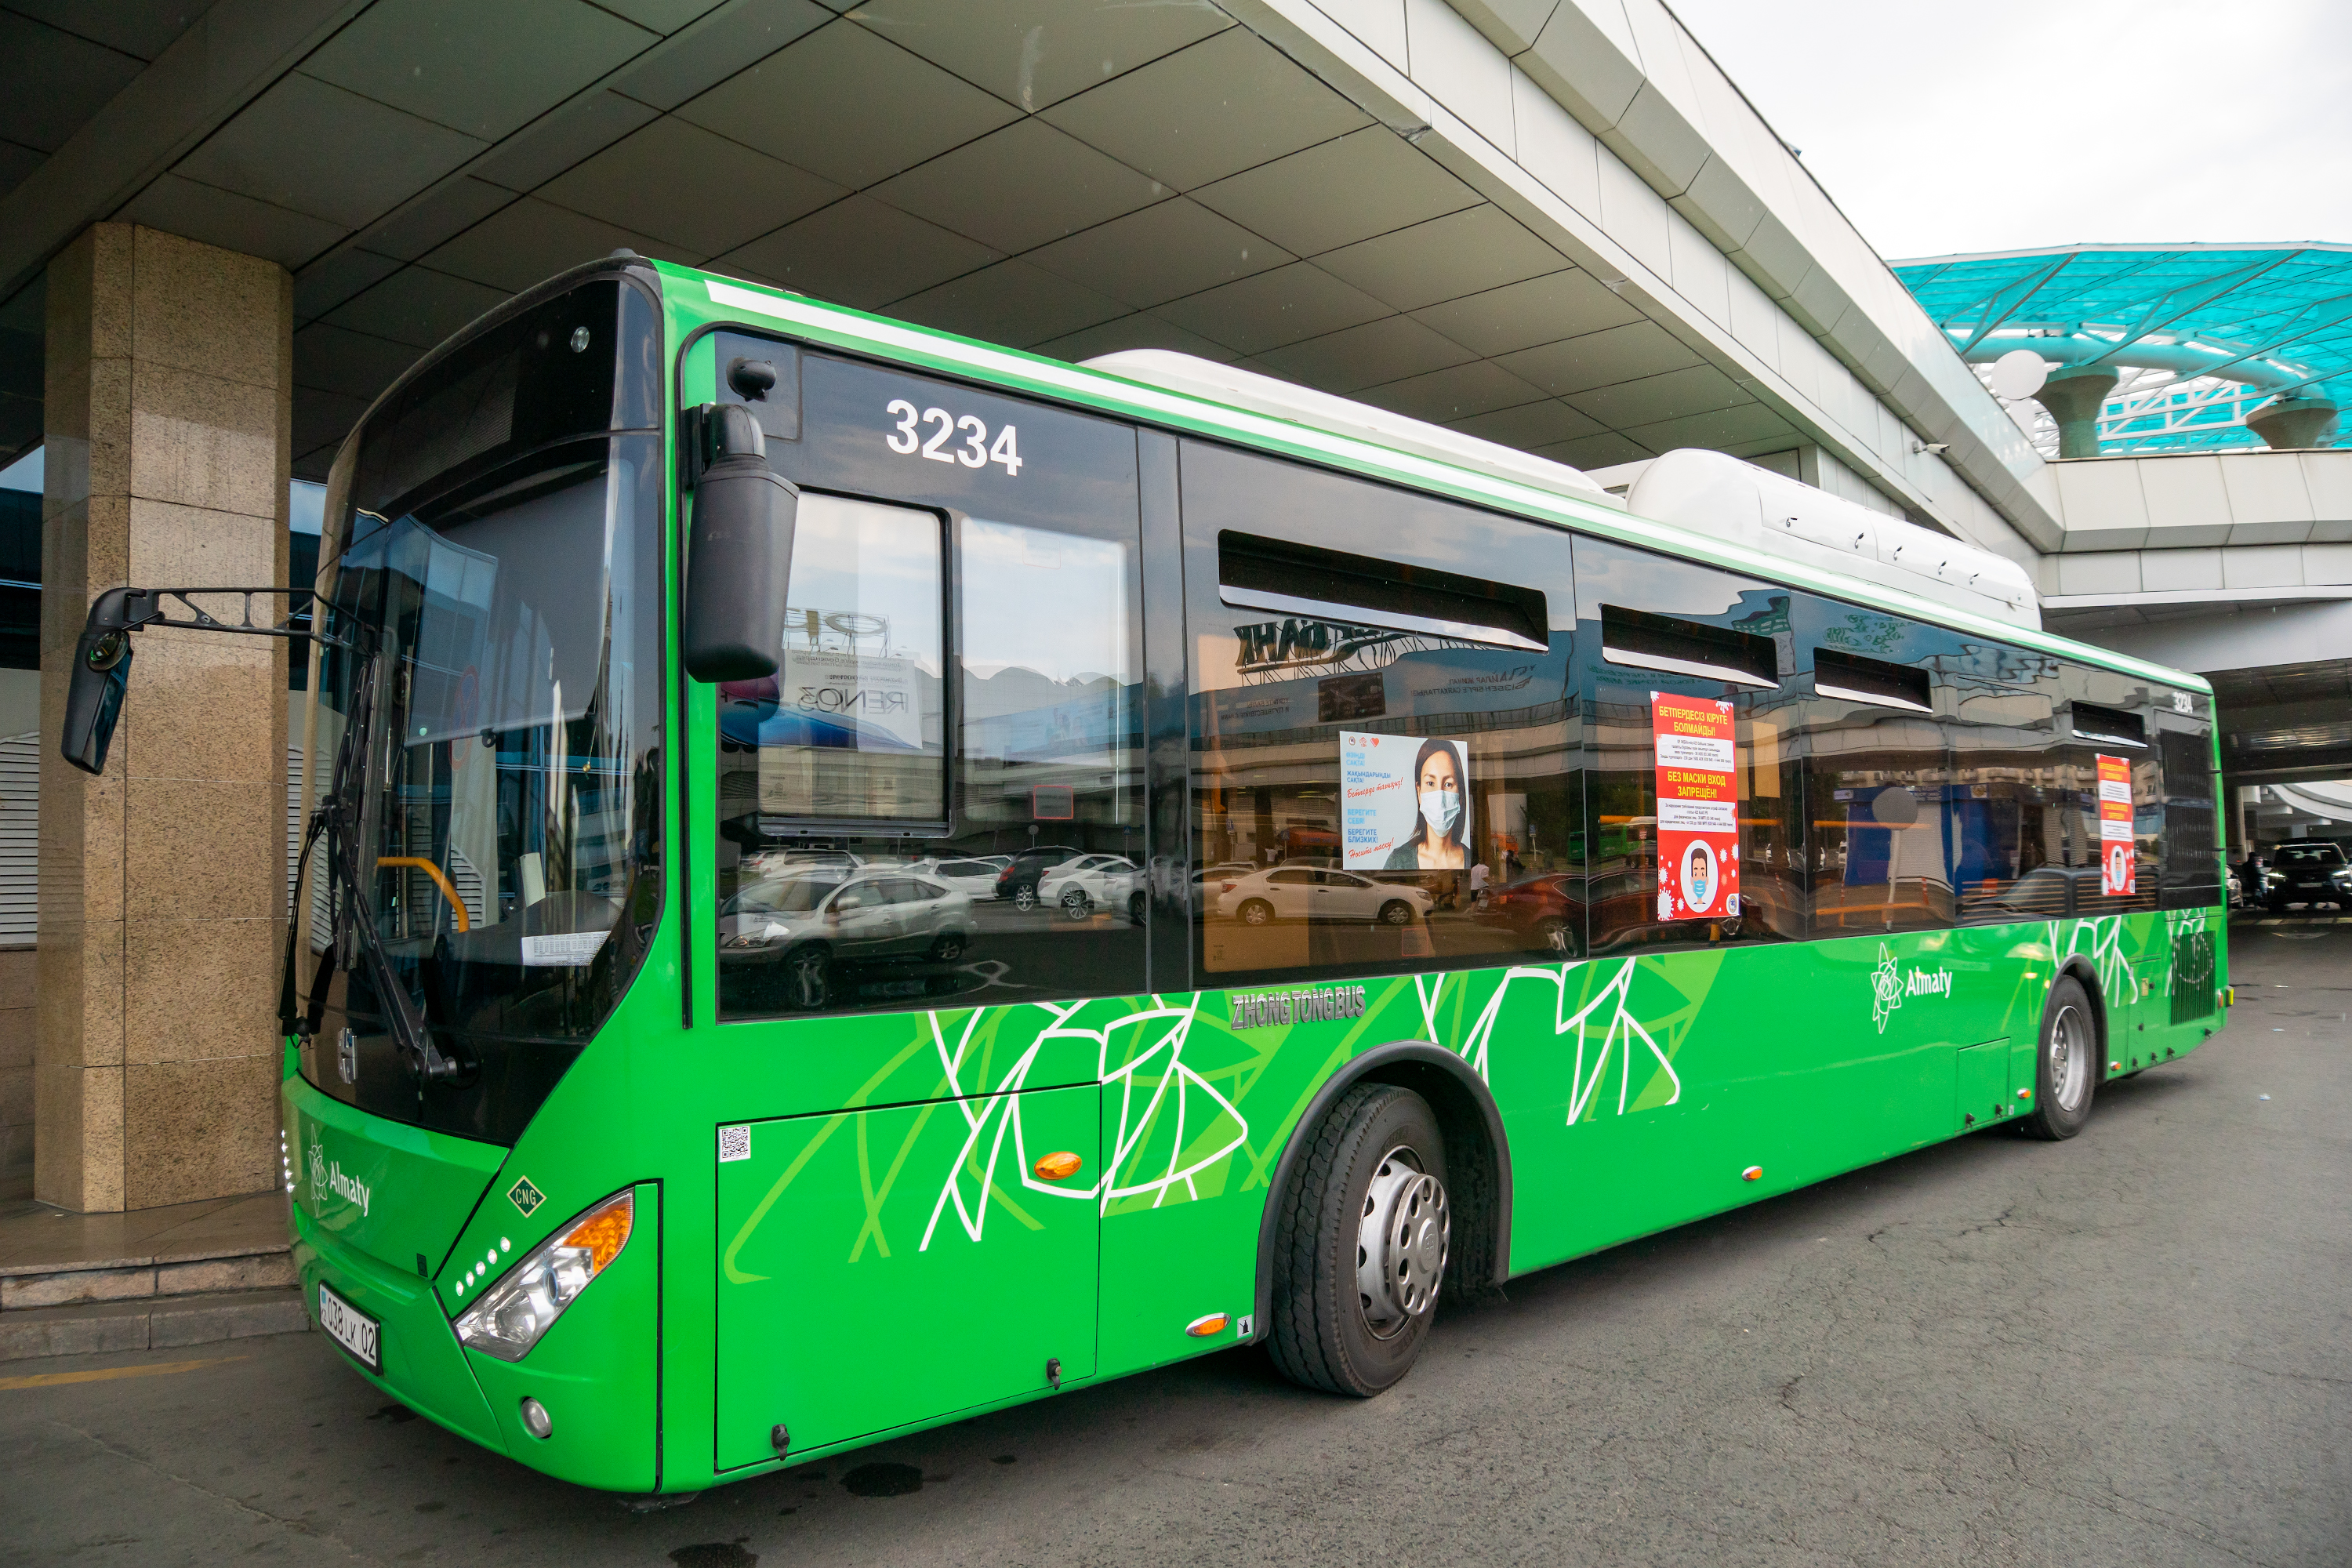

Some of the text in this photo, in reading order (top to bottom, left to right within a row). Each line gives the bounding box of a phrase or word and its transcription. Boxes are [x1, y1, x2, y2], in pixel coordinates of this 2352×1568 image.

[886, 399, 1022, 477] 3234
[2173, 691, 2193, 713] 3234
[1659, 706, 1728, 724] БЕТПЕРДЕСІЗ КІРУГЕ
[1674, 721, 1715, 736] БОЛМАЙДЫ!
[1668, 771, 1726, 787] БЕЗ МАСКИ ВХОД
[1678, 786, 1717, 799] ЗАПРЕЩЁН!
[1348, 834, 1378, 843] БЛИЗКИХ!
[1905, 966, 1952, 999] Almaty
[329, 1161, 370, 1217] Almaty
[515, 1188, 537, 1207] CNG
[345, 1318, 357, 1348] LK
[361, 1323, 376, 1360] 02
